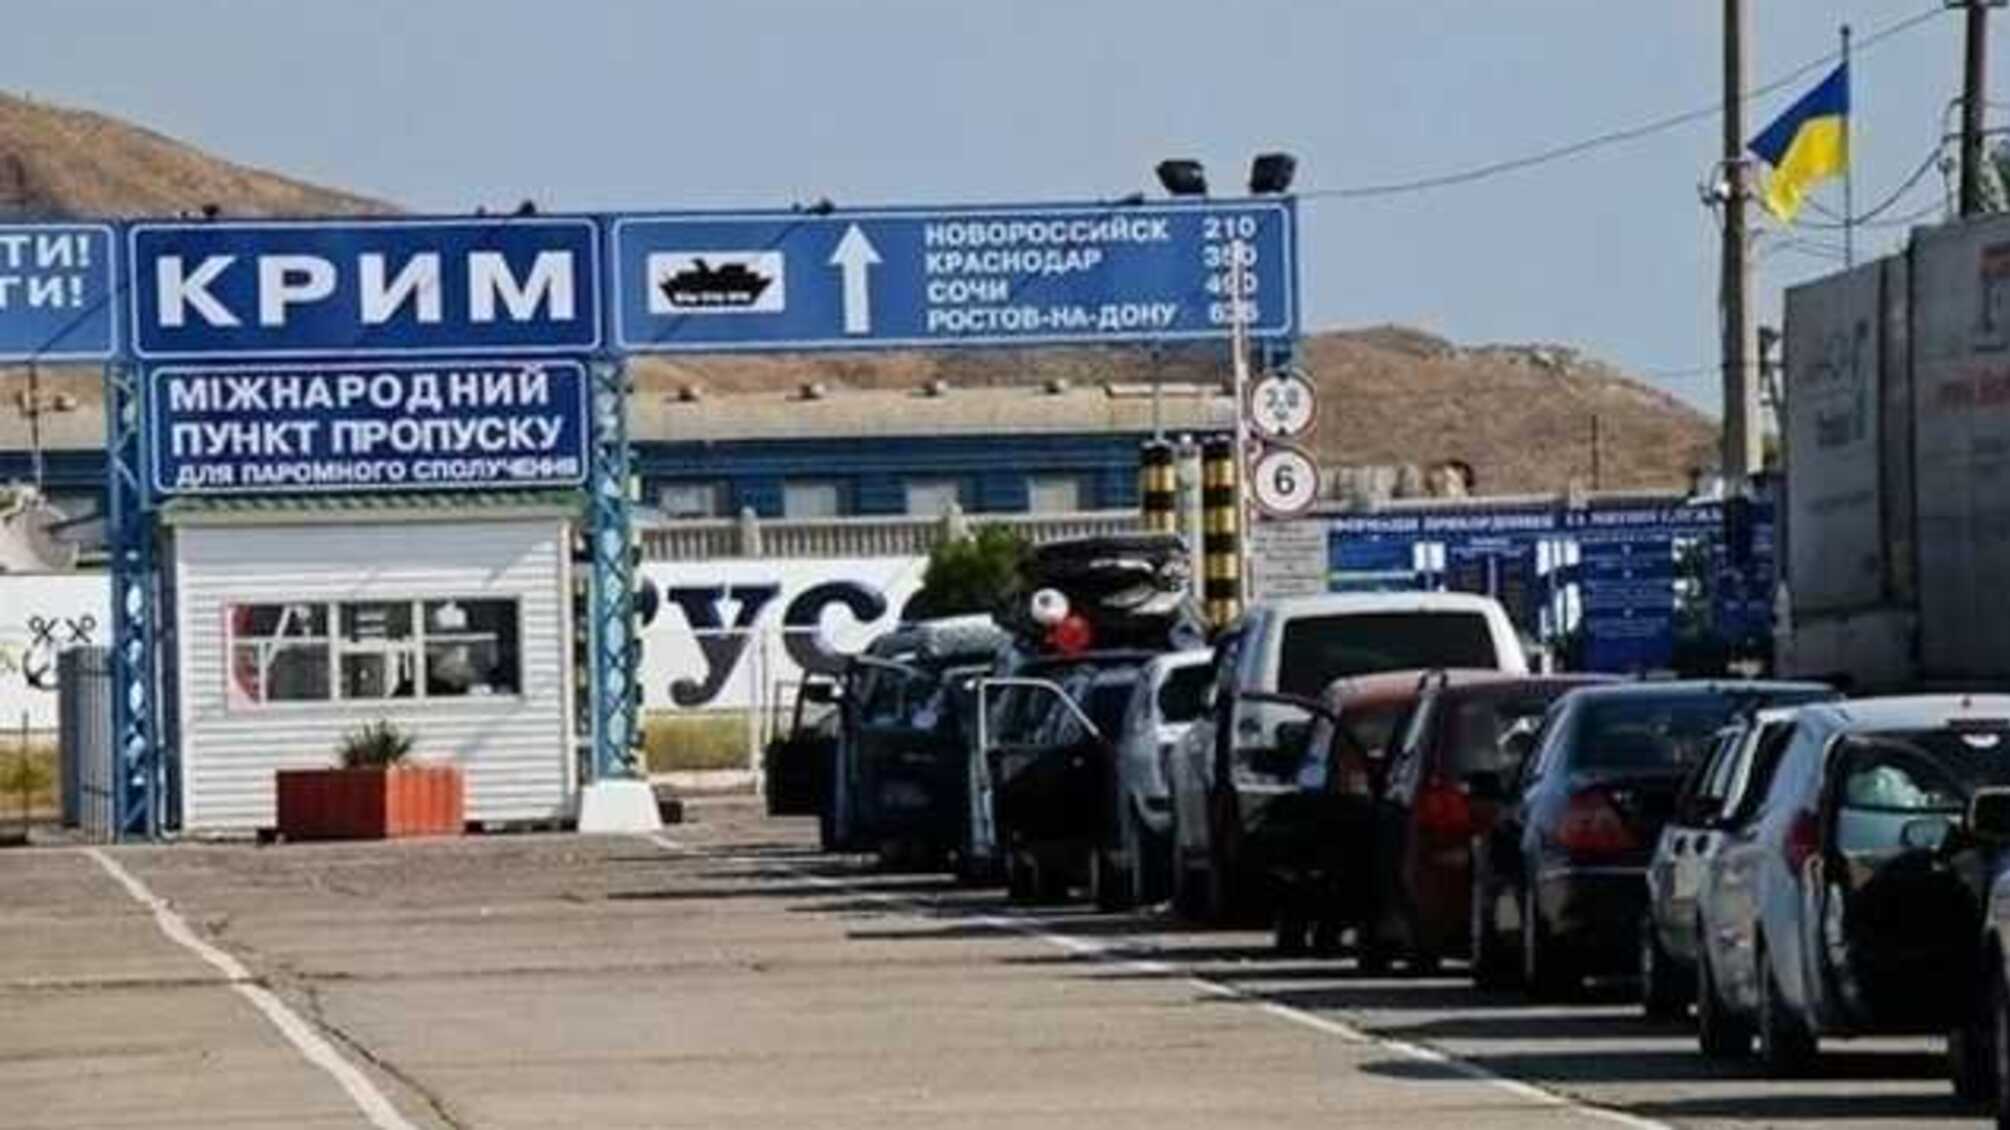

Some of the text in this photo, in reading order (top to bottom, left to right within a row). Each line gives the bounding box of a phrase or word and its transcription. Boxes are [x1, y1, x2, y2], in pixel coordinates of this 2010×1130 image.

[924, 216, 1257, 247] НОВОРОССИЙСК 210
[924, 248, 1103, 276] КРАСНОДАР
[156, 250, 576, 329] КРИМ
[925, 279, 1010, 304] СОЧИ
[925, 303, 1178, 333] РОСТОВ-НА-ДОНУ
[169, 364, 550, 412] МІЖНАРОДНИЙ
[171, 413, 564, 456] ПУНКТ ПРОПУСКУ
[175, 463, 234, 490] ДЛЯ
[240, 459, 407, 485] ПАРОМНОГО
[1272, 463, 1296, 496] 6
